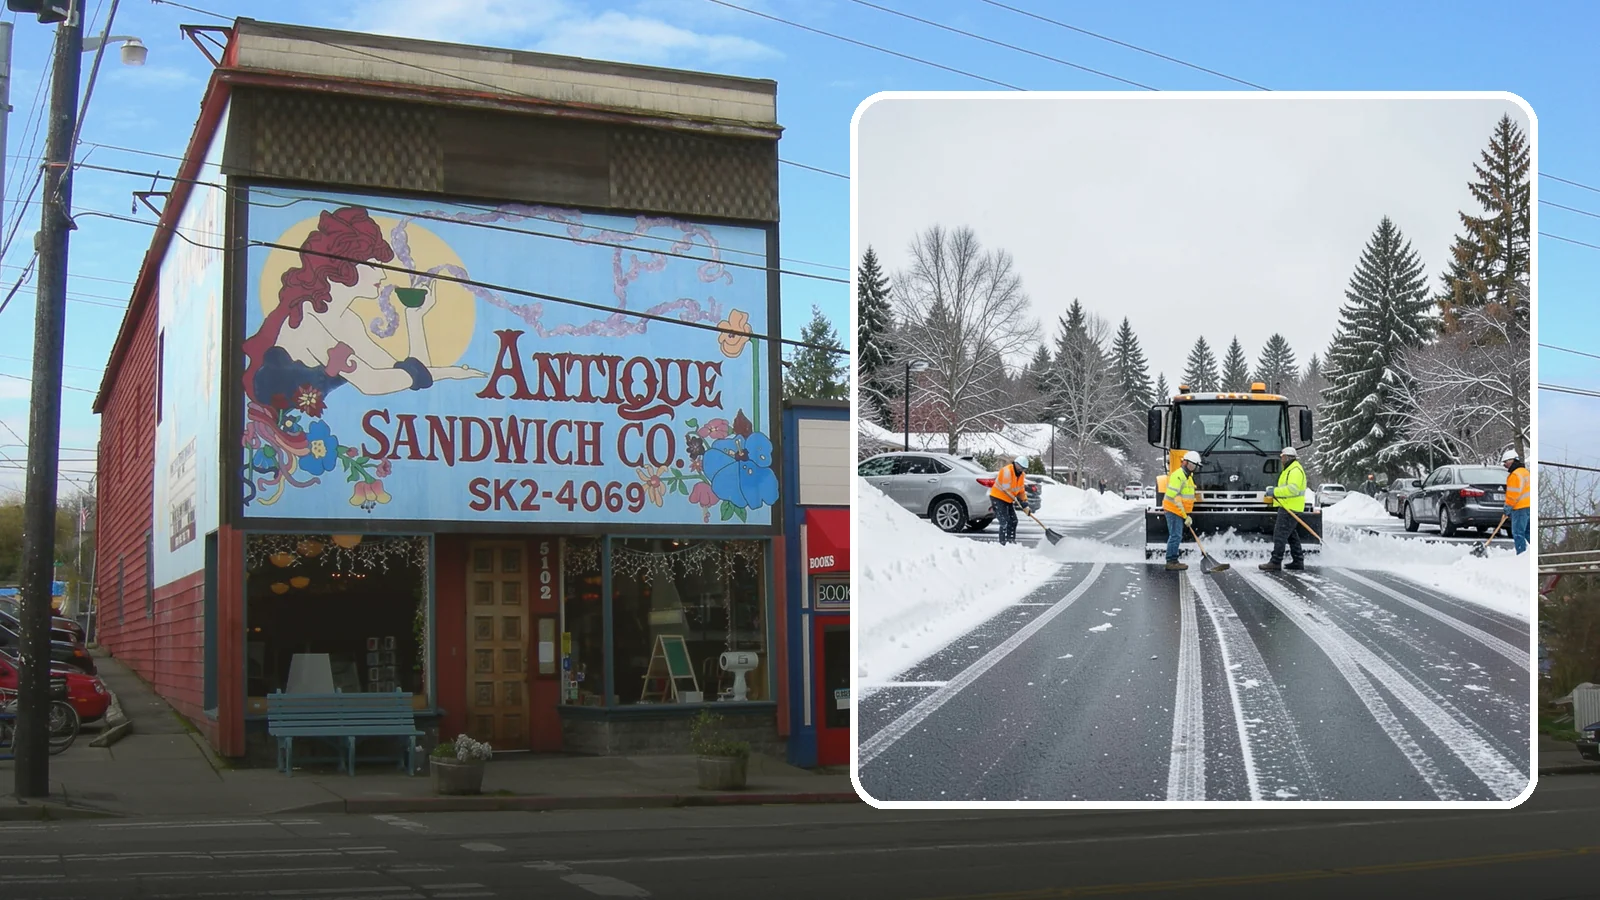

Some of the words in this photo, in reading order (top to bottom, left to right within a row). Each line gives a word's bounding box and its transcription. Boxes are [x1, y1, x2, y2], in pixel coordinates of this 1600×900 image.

[476, 329, 723, 421] ANTIQUE
[362, 408, 604, 468] SANDWICH
[617, 422, 685, 468] CO.
[468, 477, 645, 513] SK2-4069
[539, 541, 552, 600] 5102
[809, 555, 834, 569] BOOKS
